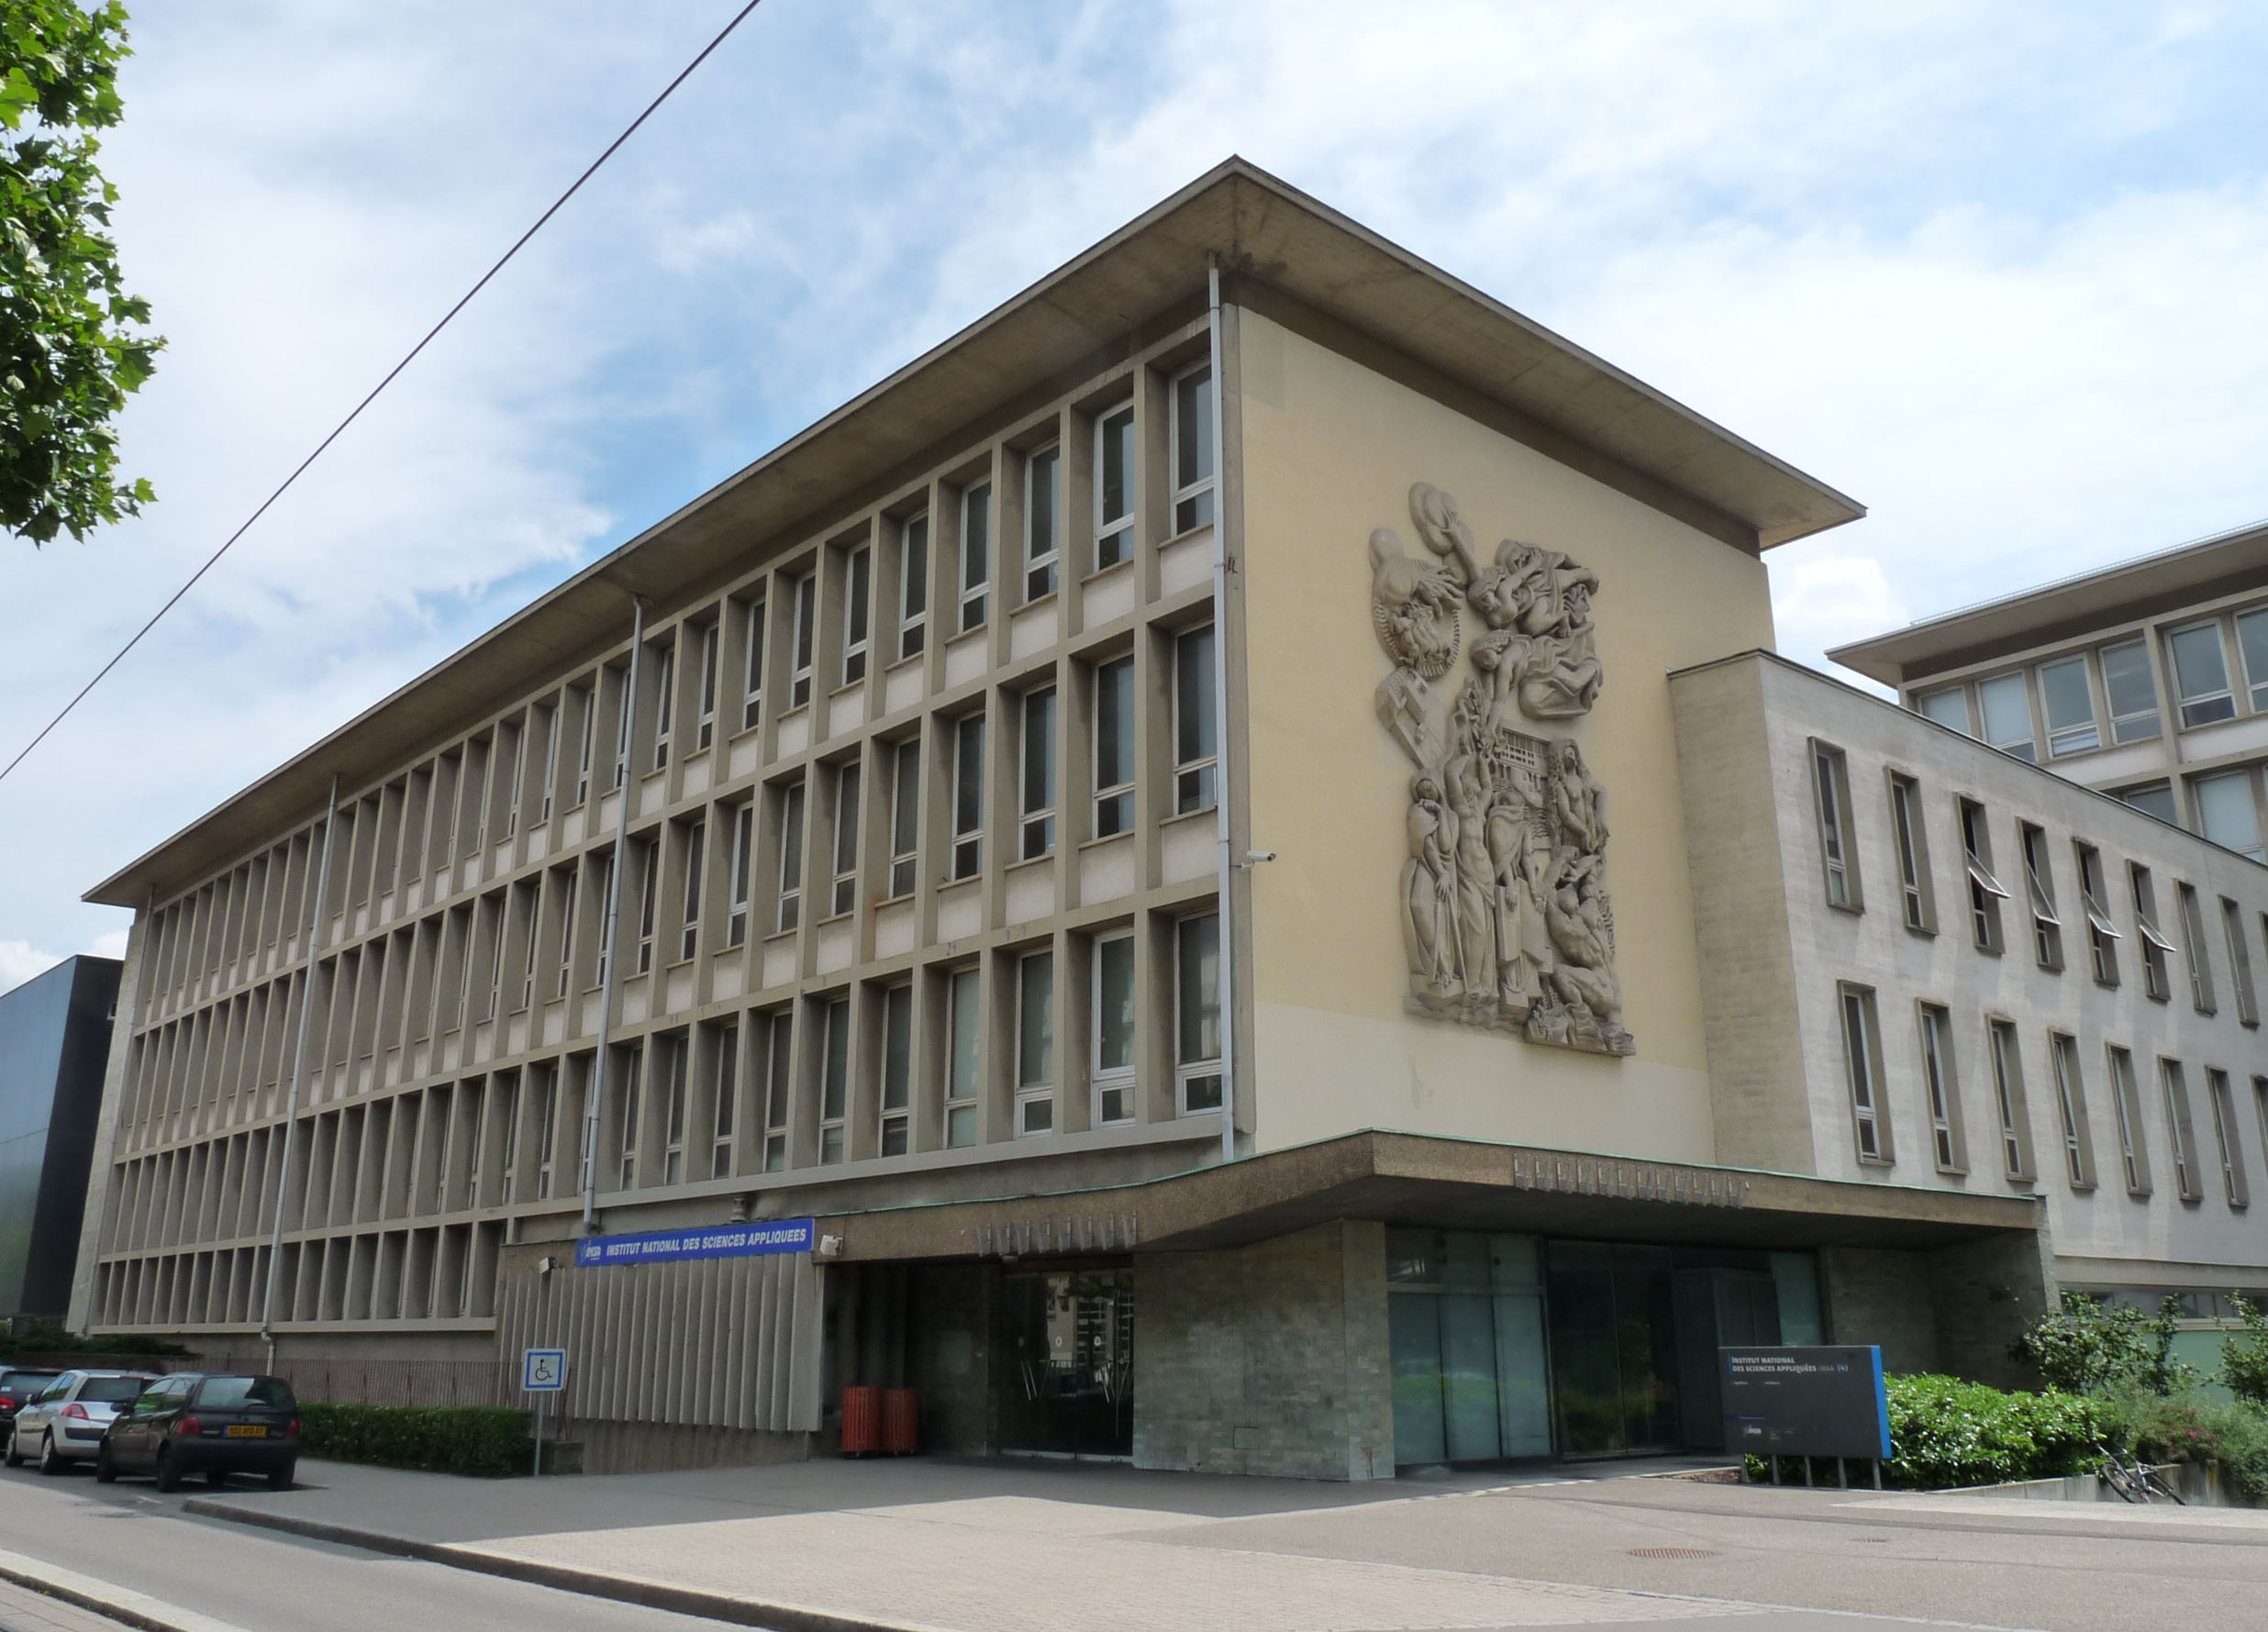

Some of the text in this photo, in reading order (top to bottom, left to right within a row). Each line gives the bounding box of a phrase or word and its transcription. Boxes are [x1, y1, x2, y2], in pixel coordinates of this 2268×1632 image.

[606, 1228, 806, 1256] INSTITUT NATIONAL DES SCIENCES APPLIQUEES
[1776, 1363, 1817, 1374] APPLIQUÉES
